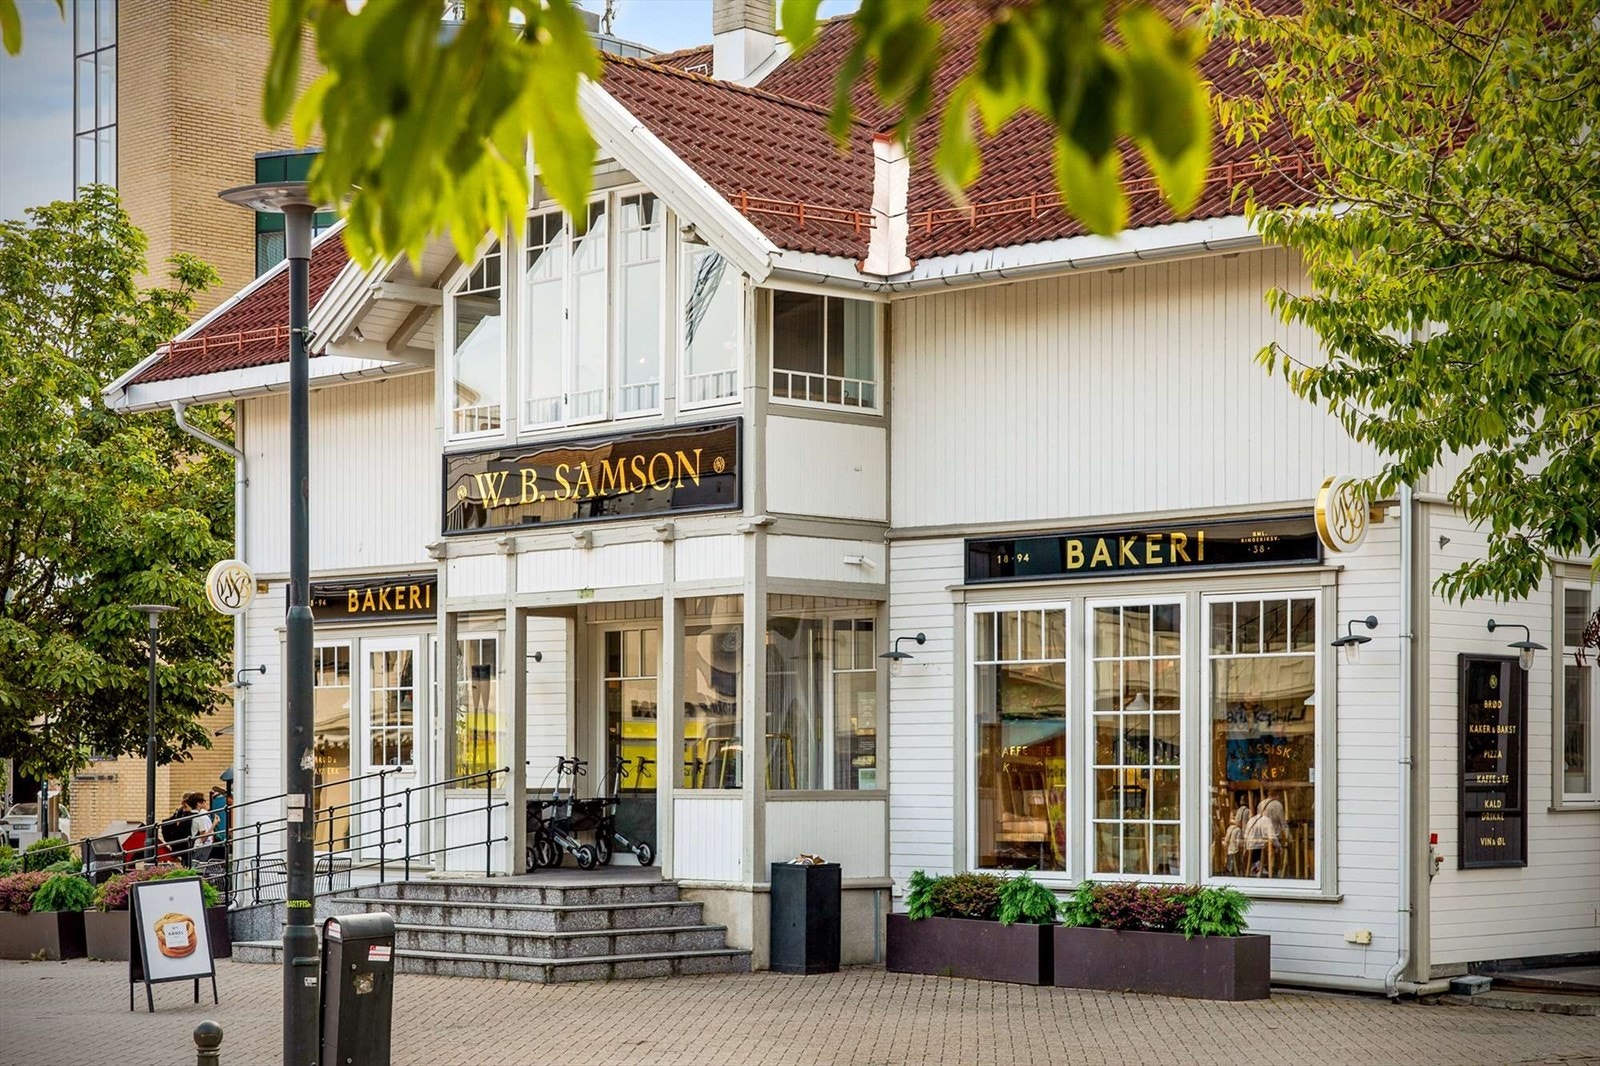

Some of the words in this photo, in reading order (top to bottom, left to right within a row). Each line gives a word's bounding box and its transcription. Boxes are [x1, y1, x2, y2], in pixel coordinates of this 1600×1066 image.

[474, 470, 510, 509] W.
[519, 468, 546, 504] B.
[554, 448, 703, 501] SAMSON
[1066, 530, 1205, 570] BAKERI
[348, 584, 431, 613] BAKERI
[1483, 700, 1503, 709] BRØD
[1469, 724, 1491, 734] KAKER
[1496, 725, 1517, 734] BAKST
[1483, 750, 1503, 759] PIZZA
[1476, 774, 1497, 783] KAFFE
[1502, 774, 1510, 783] TE
[1484, 799, 1503, 808] KALD
[1480, 837, 1492, 846] VIN
